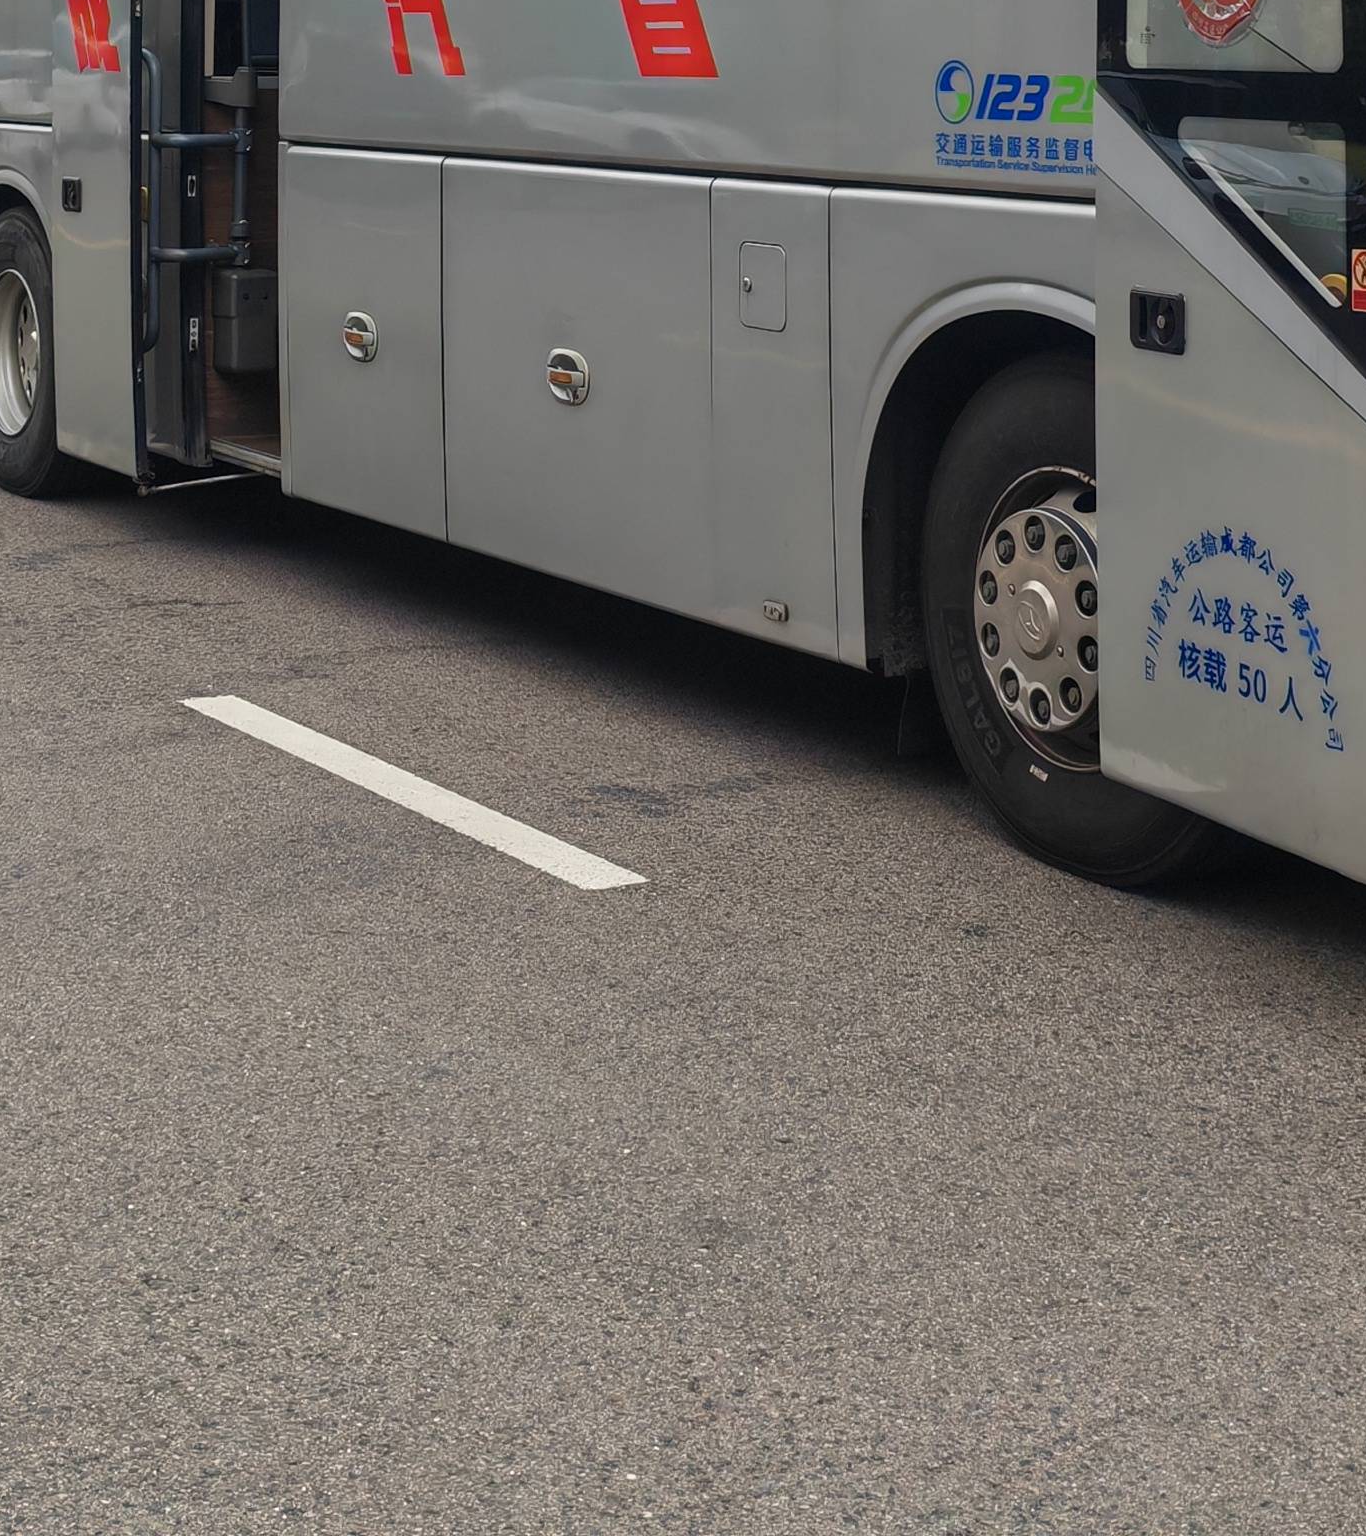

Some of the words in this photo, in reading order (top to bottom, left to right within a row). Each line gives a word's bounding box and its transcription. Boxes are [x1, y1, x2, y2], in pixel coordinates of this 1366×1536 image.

[1188, 588, 1288, 654] 公路客运
[1178, 638, 1228, 694] 核载
[1238, 663, 1267, 704] 50
[1279, 675, 1304, 722] 人
